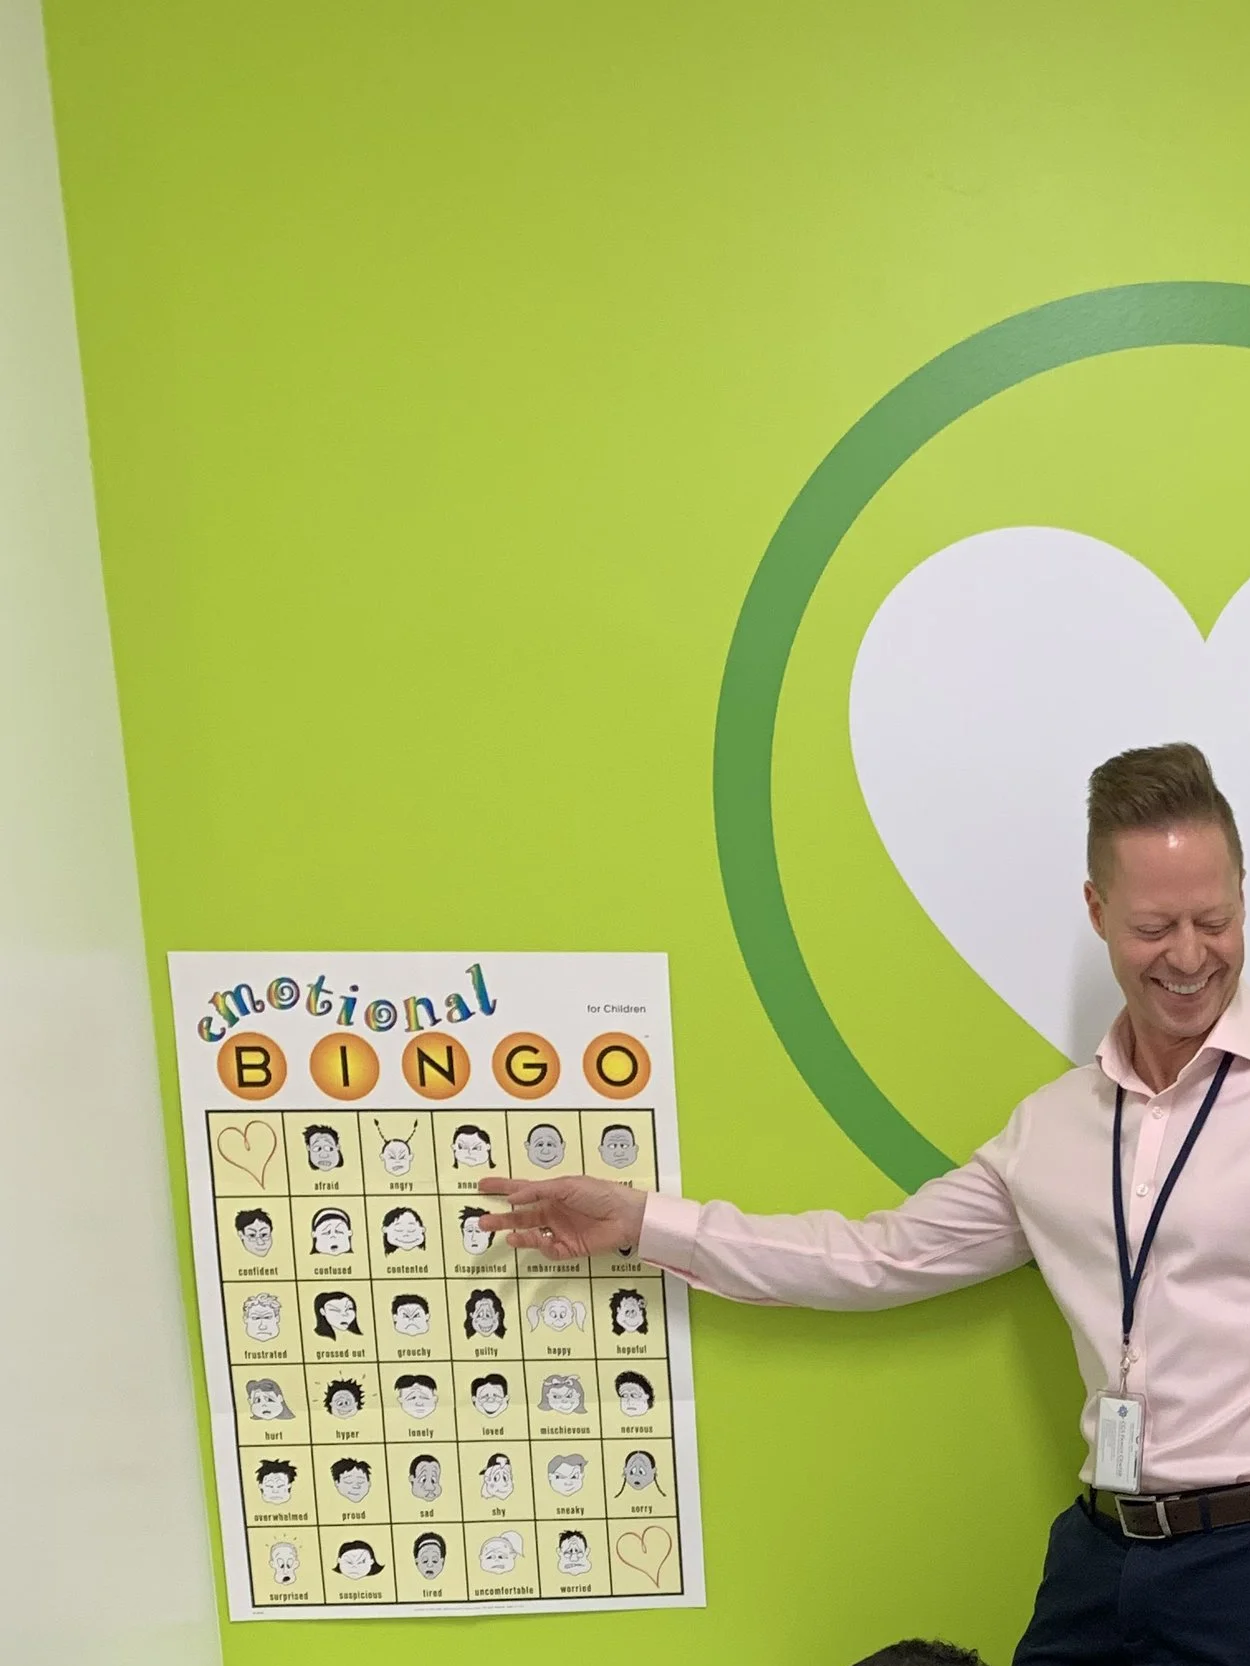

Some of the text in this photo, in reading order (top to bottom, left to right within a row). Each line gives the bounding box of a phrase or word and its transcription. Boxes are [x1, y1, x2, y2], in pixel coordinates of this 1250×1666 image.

[197, 963, 497, 1042] emotional
[586, 1004, 647, 1013] for Children
[314, 1181, 339, 1191] afraid
[389, 1181, 413, 1192] angry
[457, 1181, 480, 1190] anno
[238, 1267, 278, 1276] confident
[314, 1266, 352, 1275] confused
[386, 1265, 429, 1274] contented
[454, 1264, 507, 1274] disappointed
[527, 1263, 580, 1272] embarrassed
[611, 1262, 641, 1272] excited
[397, 1348, 431, 1358] grouchy
[474, 1347, 498, 1357] guilty
[547, 1346, 571, 1356] happy
[616, 1345, 647, 1354] hopeful
[244, 1350, 287, 1359] frustrated
[316, 1349, 365, 1360] grossed out
[408, 1428, 434, 1438] lonely
[482, 1426, 504, 1435] loved
[540, 1426, 591, 1435] mischievous
[621, 1425, 653, 1434] nervous
[265, 1431, 283, 1440] hurt
[336, 1430, 359, 1439] hyper
[420, 1509, 434, 1518] sad
[492, 1507, 506, 1517] shy
[556, 1506, 585, 1516] sneaky
[631, 1505, 653, 1514] sorry
[254, 1512, 308, 1522] overwhelmed
[342, 1511, 366, 1521] proud
[475, 1586, 534, 1596] uncomfortable
[560, 1584, 591, 1593] worried
[269, 1592, 308, 1601] surprised
[339, 1591, 382, 1600] suspicious
[422, 1589, 442, 1598] tired
